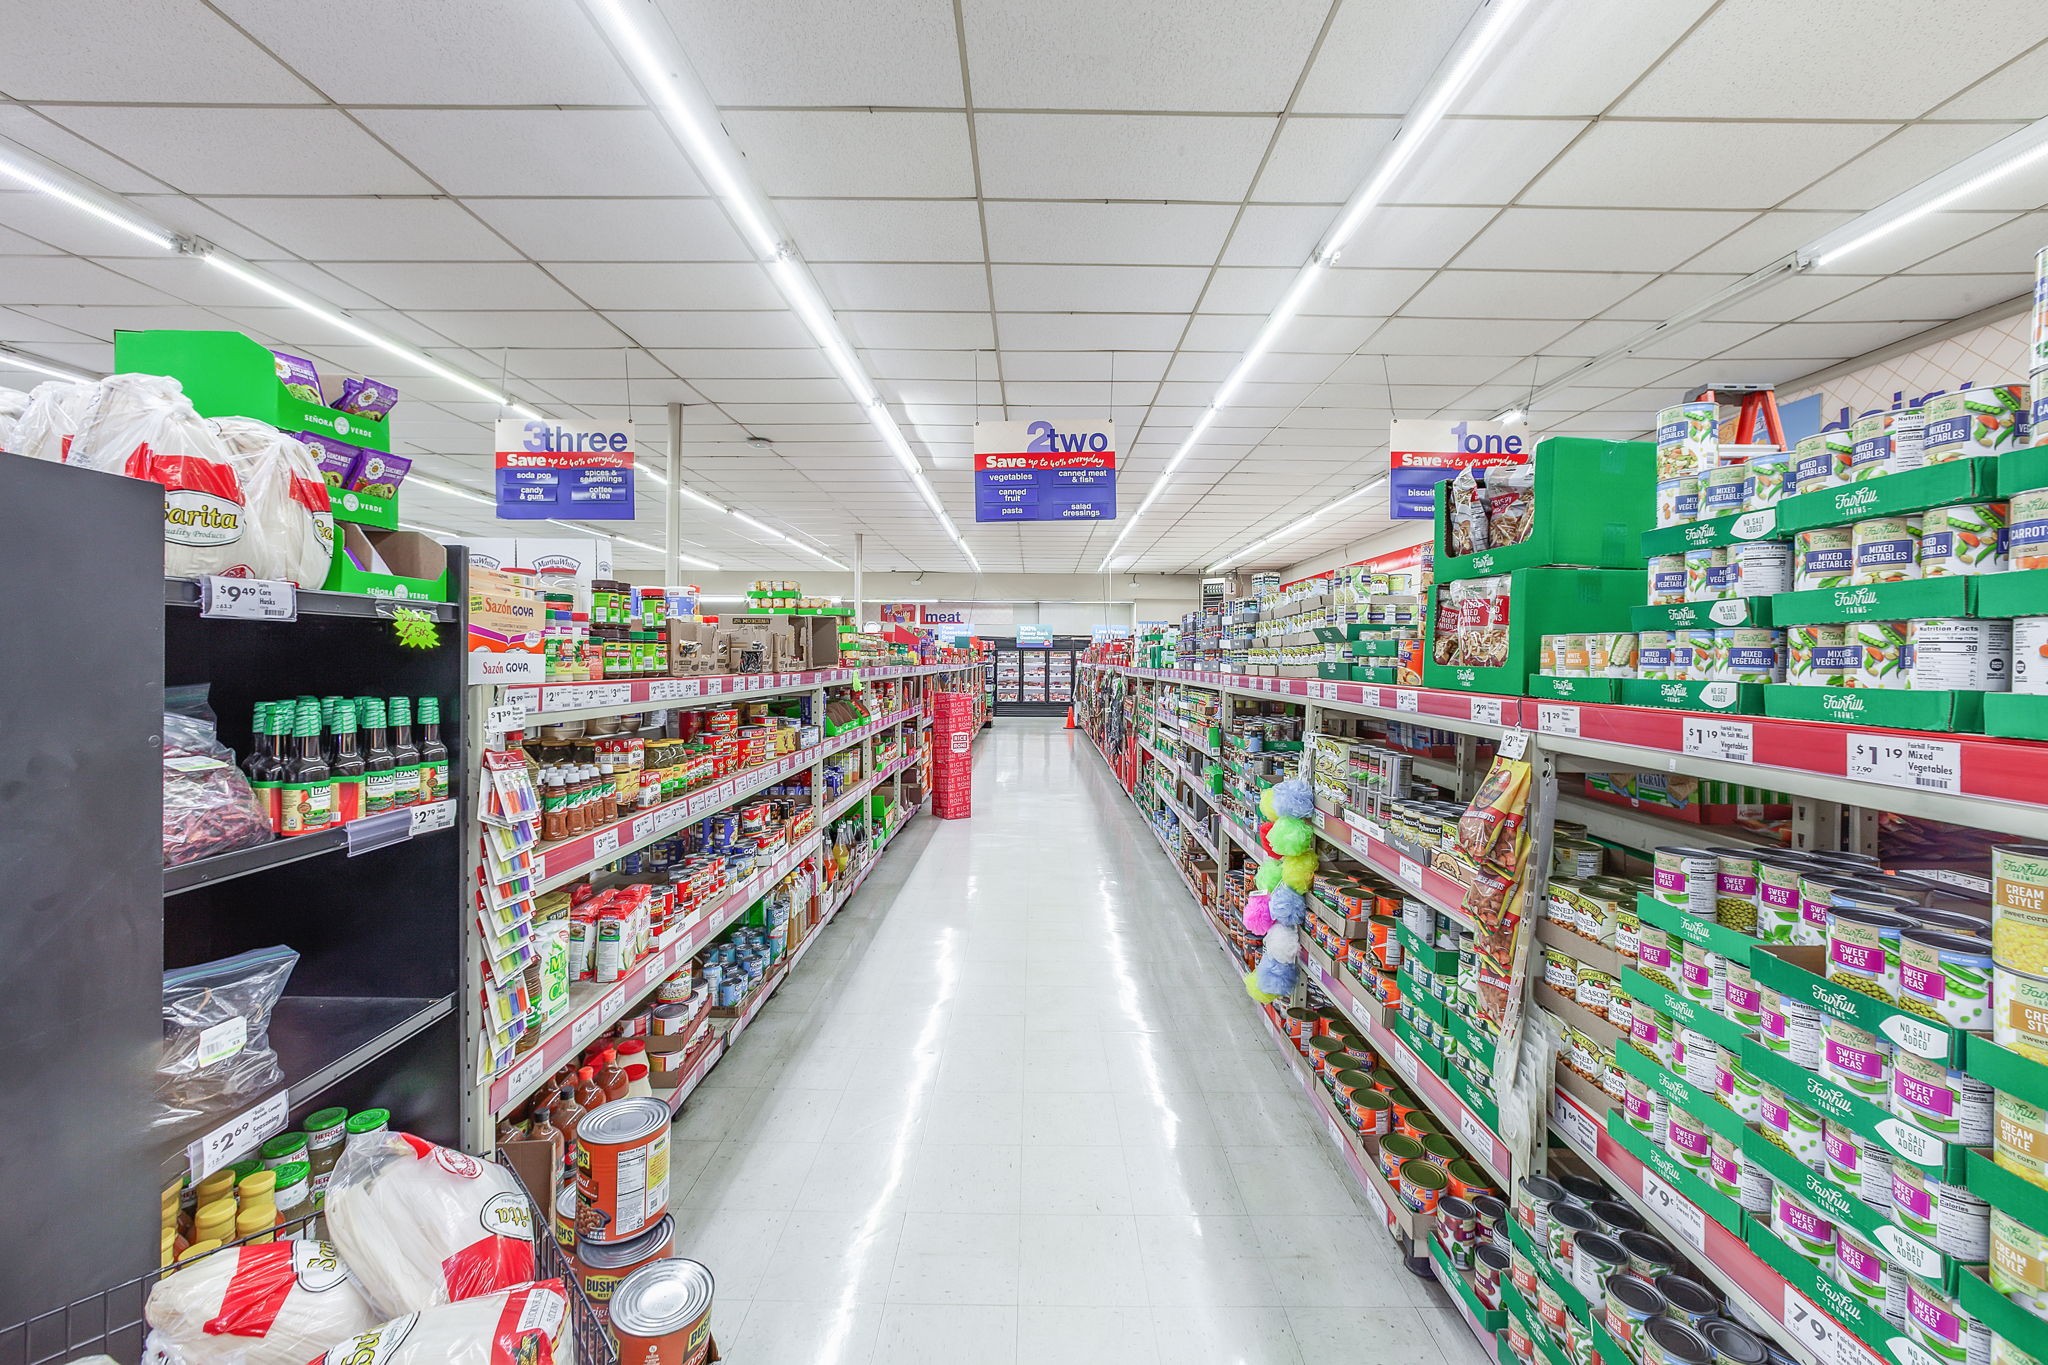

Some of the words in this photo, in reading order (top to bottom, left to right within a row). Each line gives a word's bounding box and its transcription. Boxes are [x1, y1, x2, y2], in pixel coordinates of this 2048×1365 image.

[304, 414, 333, 428] SEÑORA
[350, 426, 372, 438] VERDE
[543, 427, 628, 452] three
[1027, 421, 1053, 452] 2
[1047, 429, 1107, 452] two
[1465, 434, 1522, 454] one
[1855, 442, 1873, 453] MIXED
[507, 454, 546, 467] Save
[548, 458, 557, 468] up
[560, 457, 567, 466] to
[587, 455, 623, 468] everyday
[986, 456, 1026, 467] Save
[1028, 458, 1038, 468] up
[1040, 458, 1048, 466] to
[1050, 459, 1066, 467] 40%
[1068, 455, 1104, 467] everyday
[1402, 454, 1442, 466] Save
[1454, 458, 1462, 466] to
[1800, 460, 1817, 469] MIXED
[537, 474, 551, 482] pop
[580, 476, 622, 484] seasonings
[585, 470, 609, 478] spices
[989, 473, 1032, 481] vegetables
[521, 486, 543, 494] candy
[528, 494, 544, 502] gum
[1835, 487, 1877, 508] Fairhill
[360, 502, 383, 513] VERDE
[1063, 509, 1100, 517] dressings
[1846, 505, 1867, 515] FARMS
[1753, 516, 1764, 525] SALT
[1685, 524, 1716, 541] Fairhill
[1746, 524, 1763, 533] ADDED
[1860, 552, 1907, 563] VEGETABLES
[1809, 560, 1853, 570] VEGETABLES
[366, 587, 394, 597] SEÑORA
[408, 592, 429, 600] VERDE
[1835, 588, 1877, 606] Fairhill
[485, 597, 512, 615] Sazón
[512, 606, 534, 618] GOYA
[1846, 606, 1867, 614] FARMS
[926, 612, 961, 622] meat
[1722, 612, 1737, 620] ADDED
[483, 661, 503, 674] Sazón
[506, 662, 529, 673] GOYA
[1732, 657, 1771, 665] VEGETABLES
[1718, 687, 1728, 695] SALT
[1721, 741, 1748, 751] Vegetables
[1927, 744, 1944, 752] Farms
[1908, 751, 1933, 761] Mixed
[395, 769, 419, 779] LIZANO
[1908, 762, 1953, 775] Vegetables
[367, 774, 393, 785] LIZANO
[1657, 872, 1675, 881] SWEET
[1659, 878, 1672, 888] PEAS
[1723, 876, 1746, 887] SWEET
[1726, 884, 1744, 893] PEAS
[1768, 887, 1790, 900] SWEET
[2006, 884, 2044, 900] CREAM
[1770, 894, 1787, 905] PEAS
[2008, 894, 2041, 910] STYLE
[2004, 909, 2024, 920] sweet
[2026, 914, 2048, 924] corn
[1839, 944, 1870, 959] SWEET
[1842, 952, 1865, 967] PEAS
[1903, 966, 1928, 983] SWEET
[1904, 974, 1925, 991] PEAS
[1900, 1022, 1911, 1032] NO
[1912, 1026, 1931, 1043] SALT
[1903, 1035, 1927, 1051] ADDED
[253, 1114, 280, 1133] Seasoning
[315, 1125, 344, 1140] HERDEZ
[2000, 1119, 2034, 1143] CREAM
[1907, 1132, 1926, 1148] SALT
[2001, 1131, 2032, 1153] STYLE
[1898, 1140, 1922, 1157] ADDED
[2014, 1154, 2037, 1167] corn
[1995, 1240, 2027, 1267] CREAM
[1996, 1253, 2024, 1276] STYLE
[1837, 1331, 1857, 1352] Fairhill
